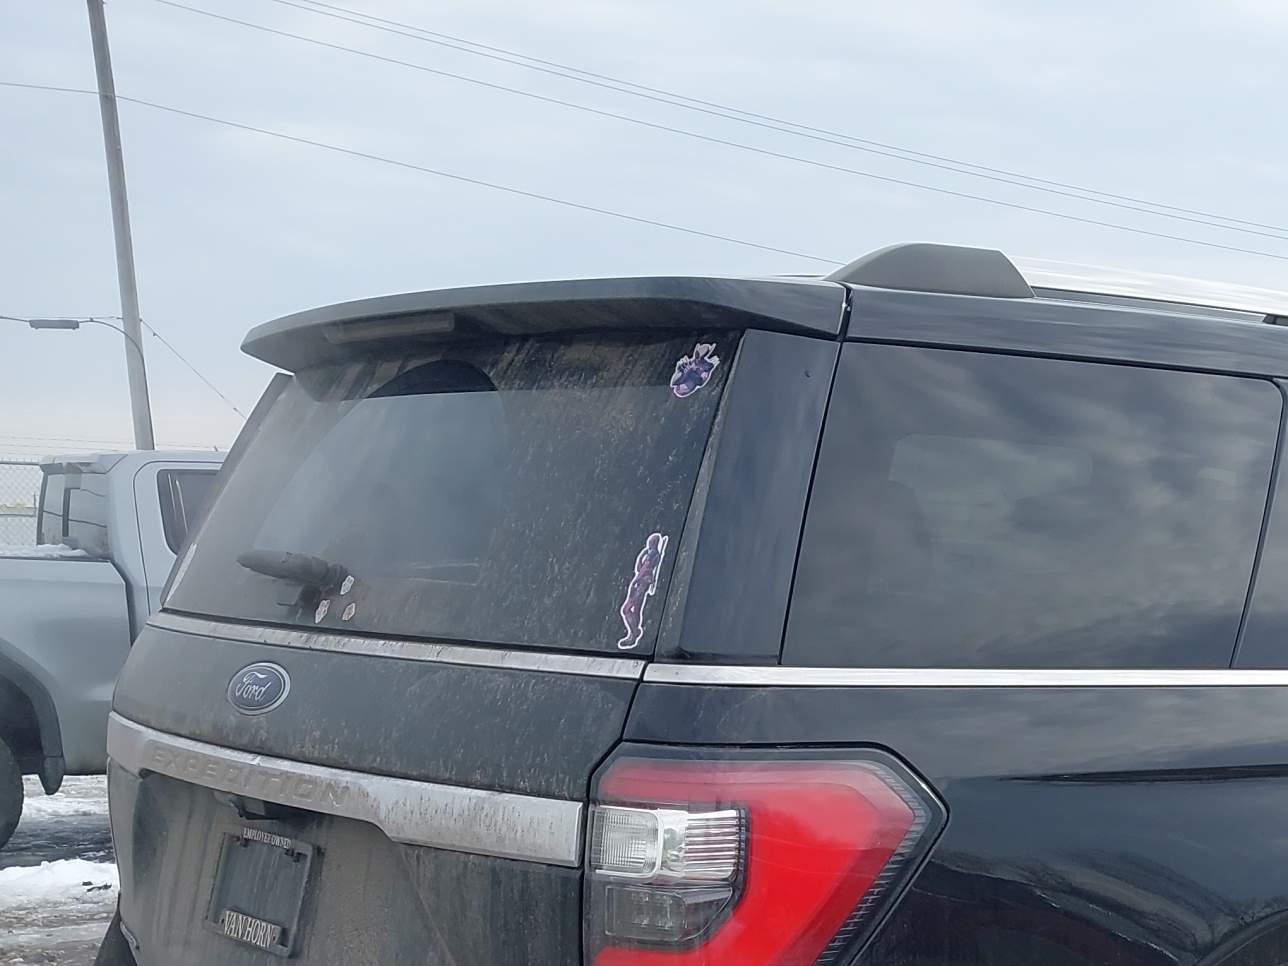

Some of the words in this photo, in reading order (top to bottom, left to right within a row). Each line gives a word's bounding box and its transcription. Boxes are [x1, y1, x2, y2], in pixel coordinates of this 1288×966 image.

[235, 671, 272, 701] Ford
[151, 745, 352, 810] EXPEDITION
[224, 910, 247, 938] VAN
[243, 917, 275, 949] HORN
